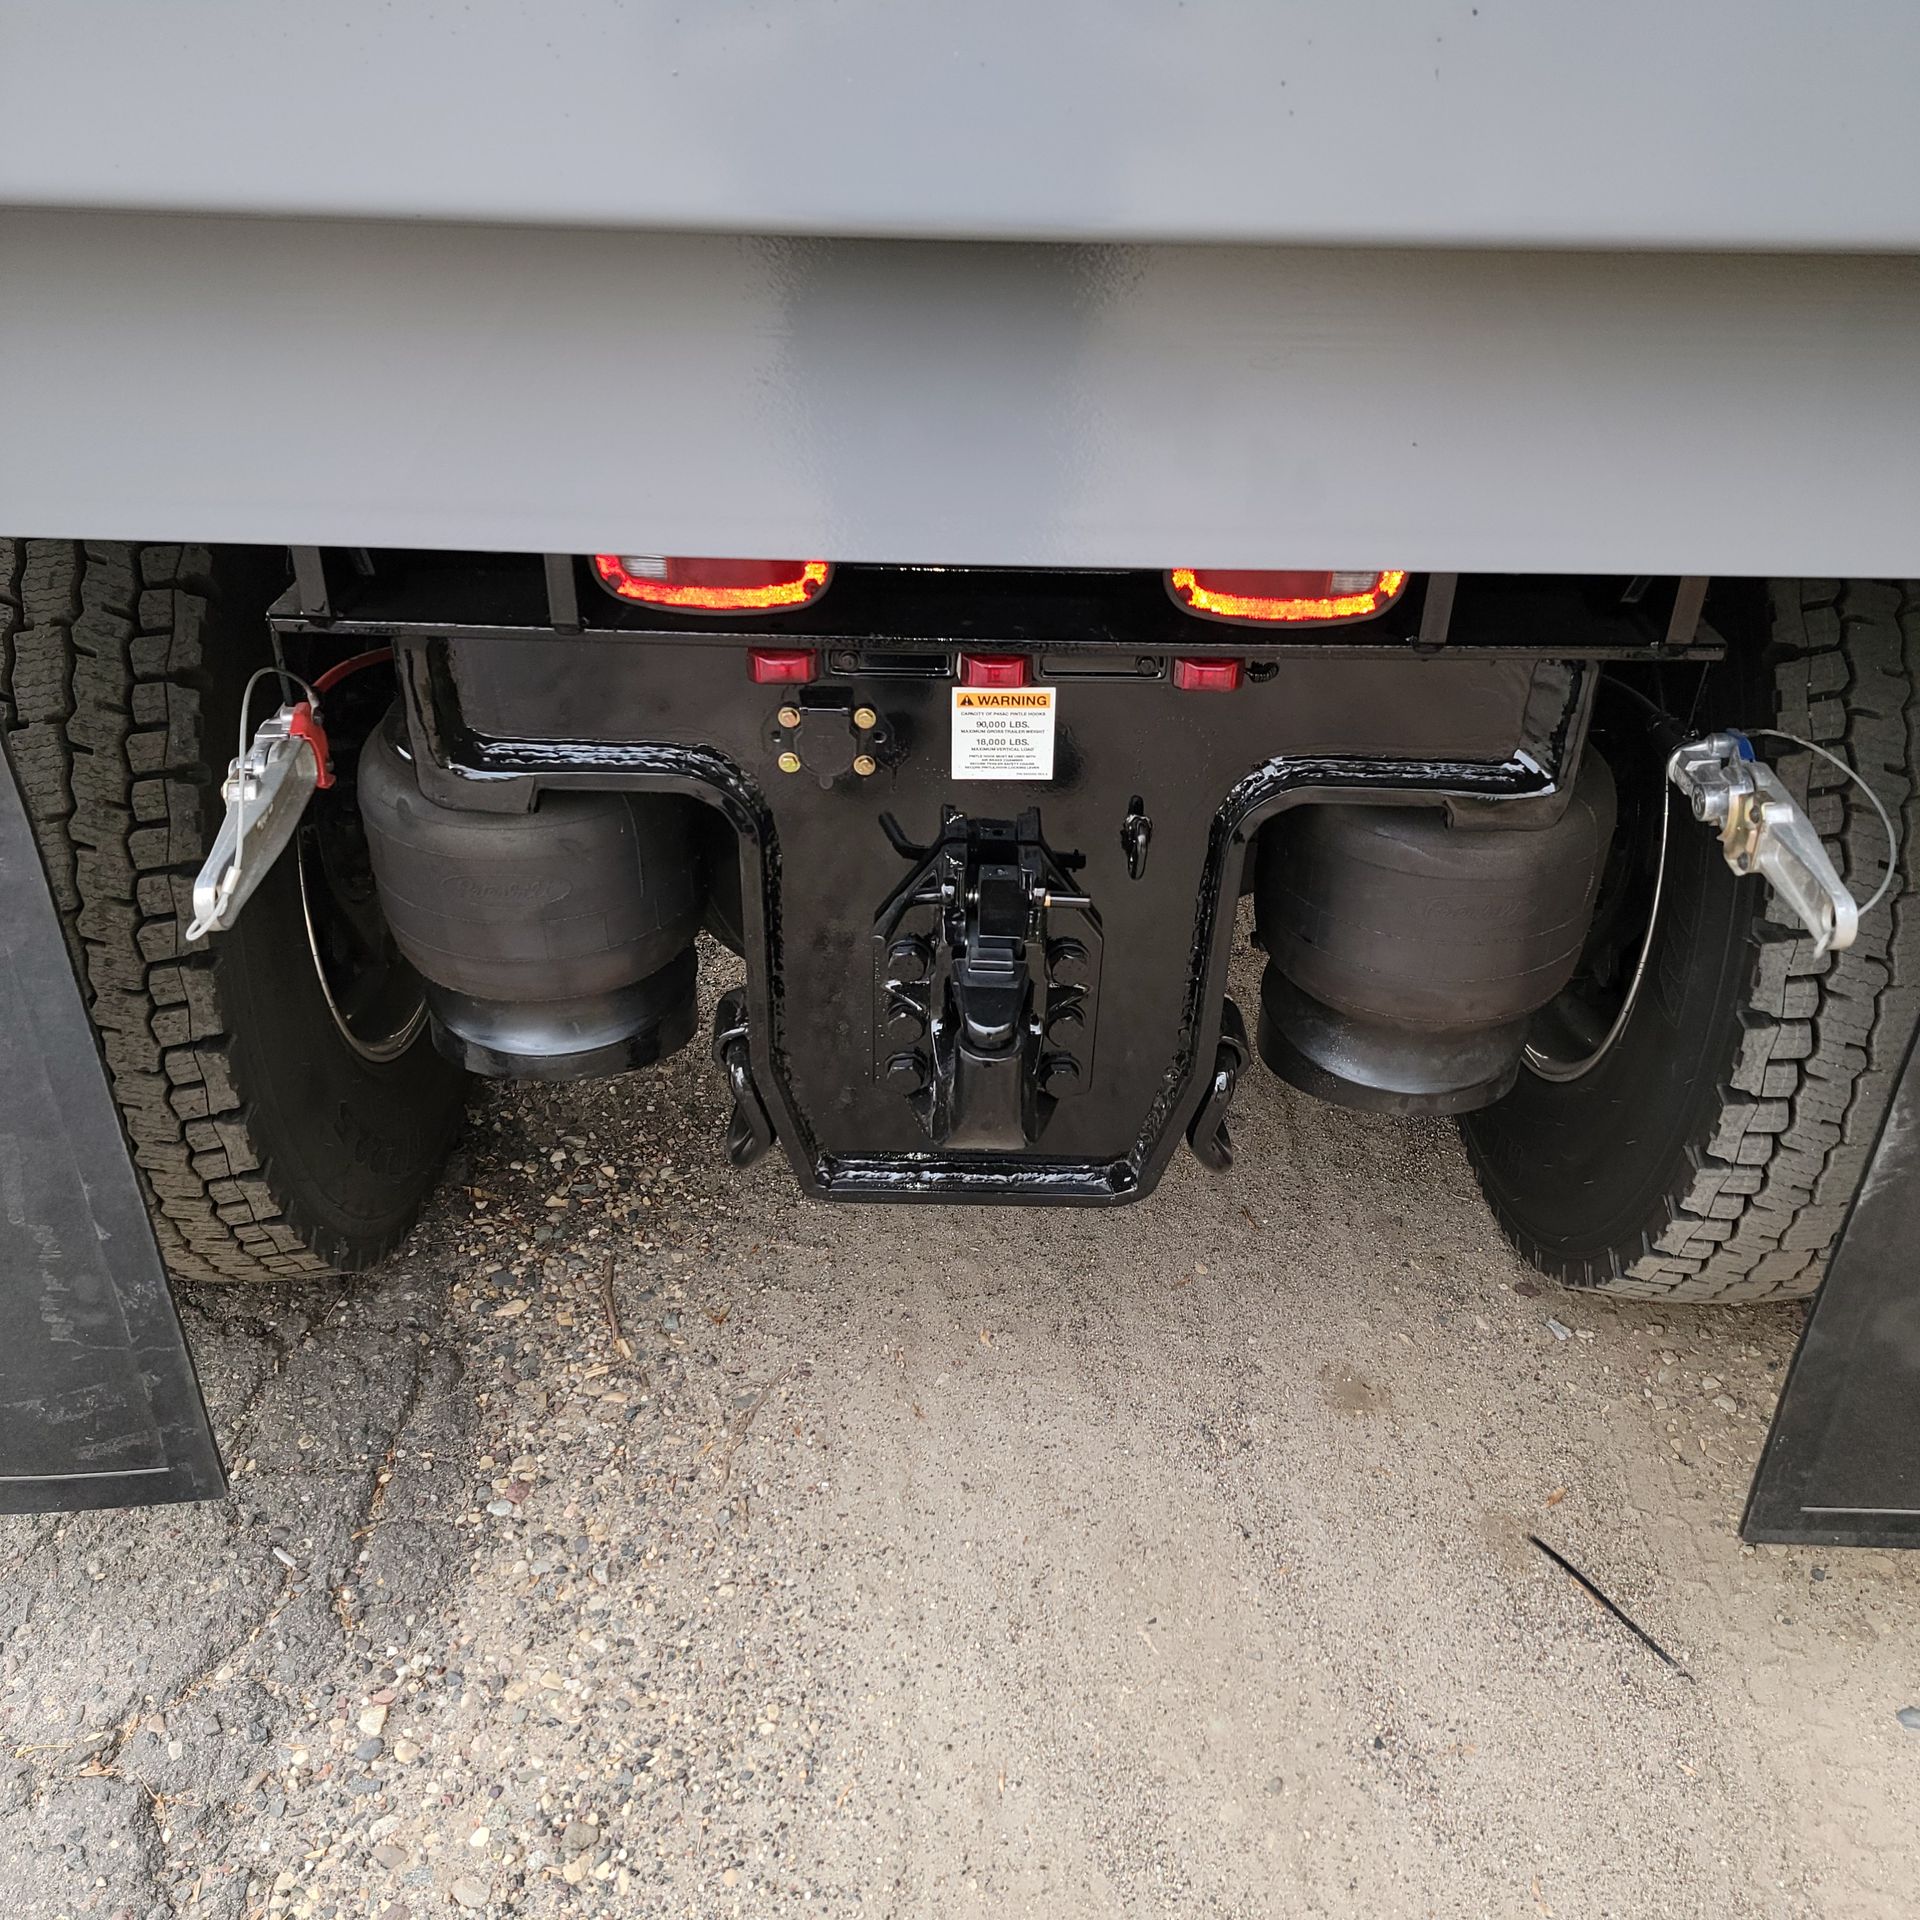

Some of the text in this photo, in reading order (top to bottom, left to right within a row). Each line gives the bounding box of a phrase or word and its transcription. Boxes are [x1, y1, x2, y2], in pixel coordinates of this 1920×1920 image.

[977, 696, 1047, 706] WARNING
[976, 720, 1030, 729] 90,000 LBS.
[976, 738, 1030, 746] 18,000 LBS.
